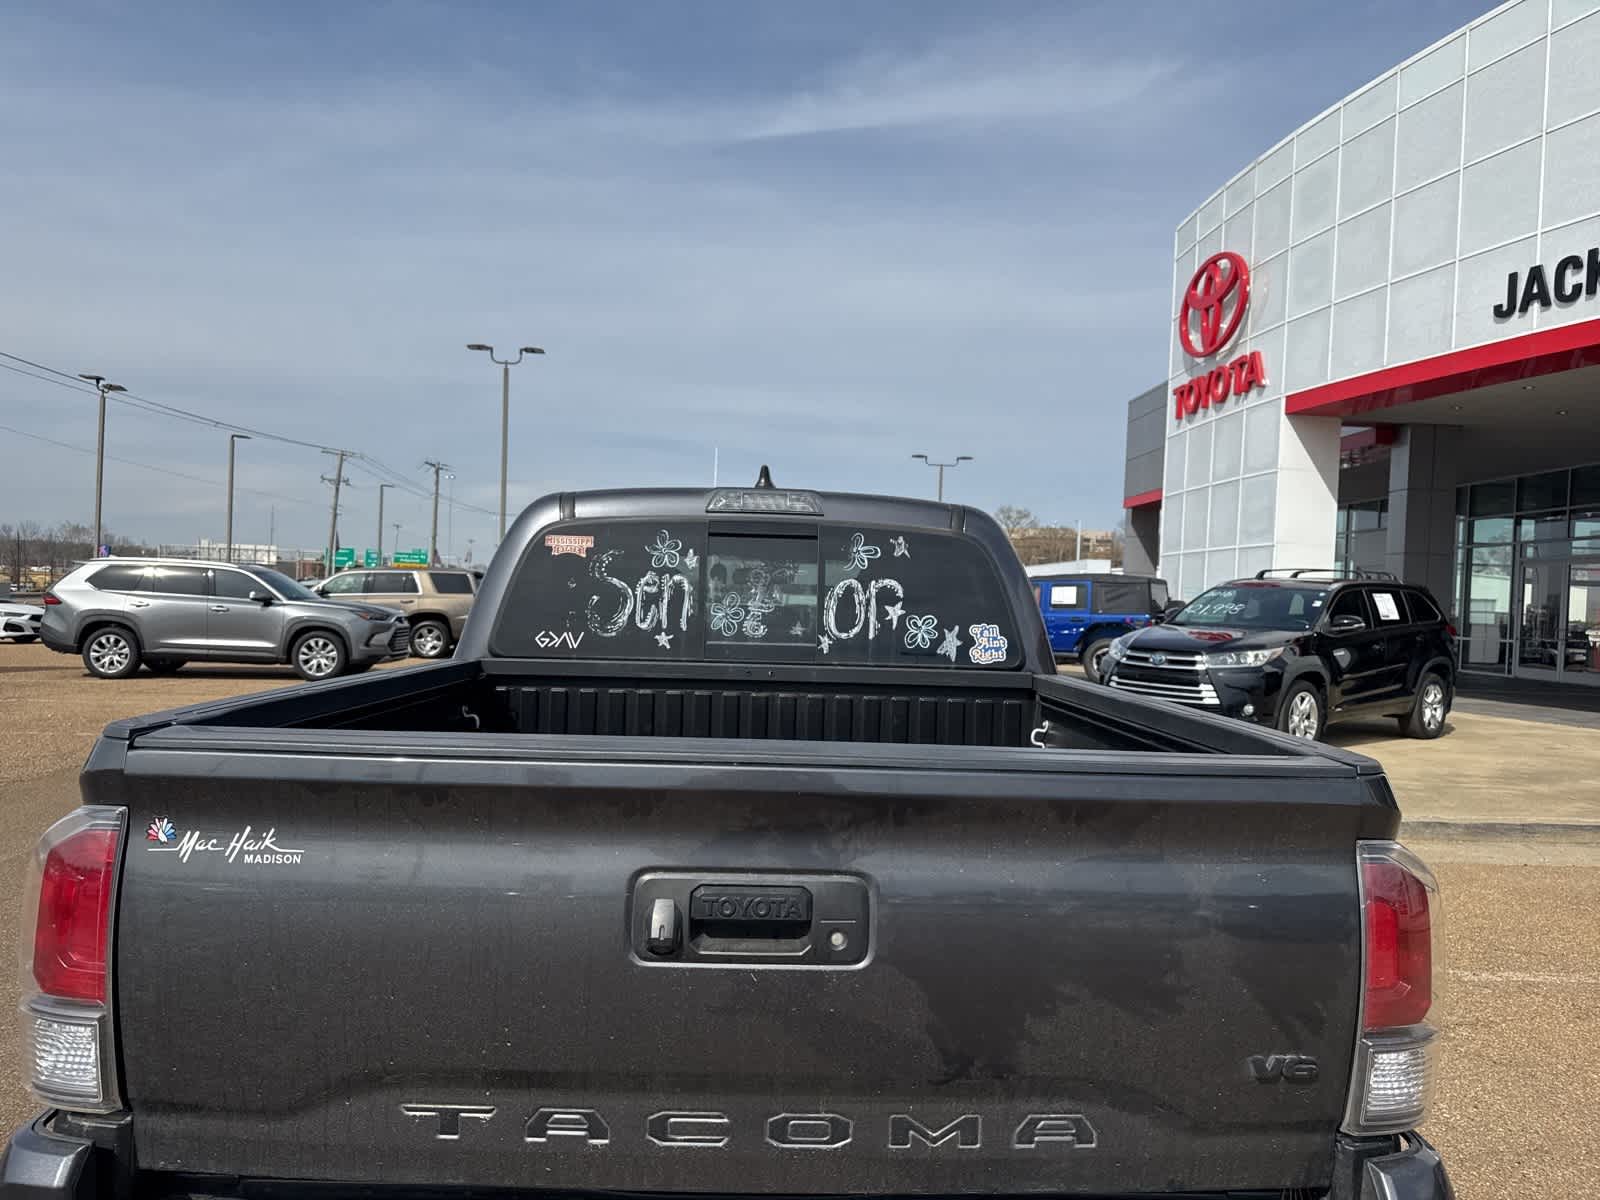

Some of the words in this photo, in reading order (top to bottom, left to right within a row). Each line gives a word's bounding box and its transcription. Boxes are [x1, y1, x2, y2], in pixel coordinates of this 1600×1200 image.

[1172, 350, 1266, 420] TOYOTA
[972, 648, 1004, 661] Right
[176, 830, 224, 863] Mac
[225, 825, 286, 863] Haik
[244, 854, 302, 864] MADISON
[701, 896, 803, 919] TOYOTA
[1247, 1054, 1319, 1081] V6
[400, 1103, 1097, 1149] TACOMA
